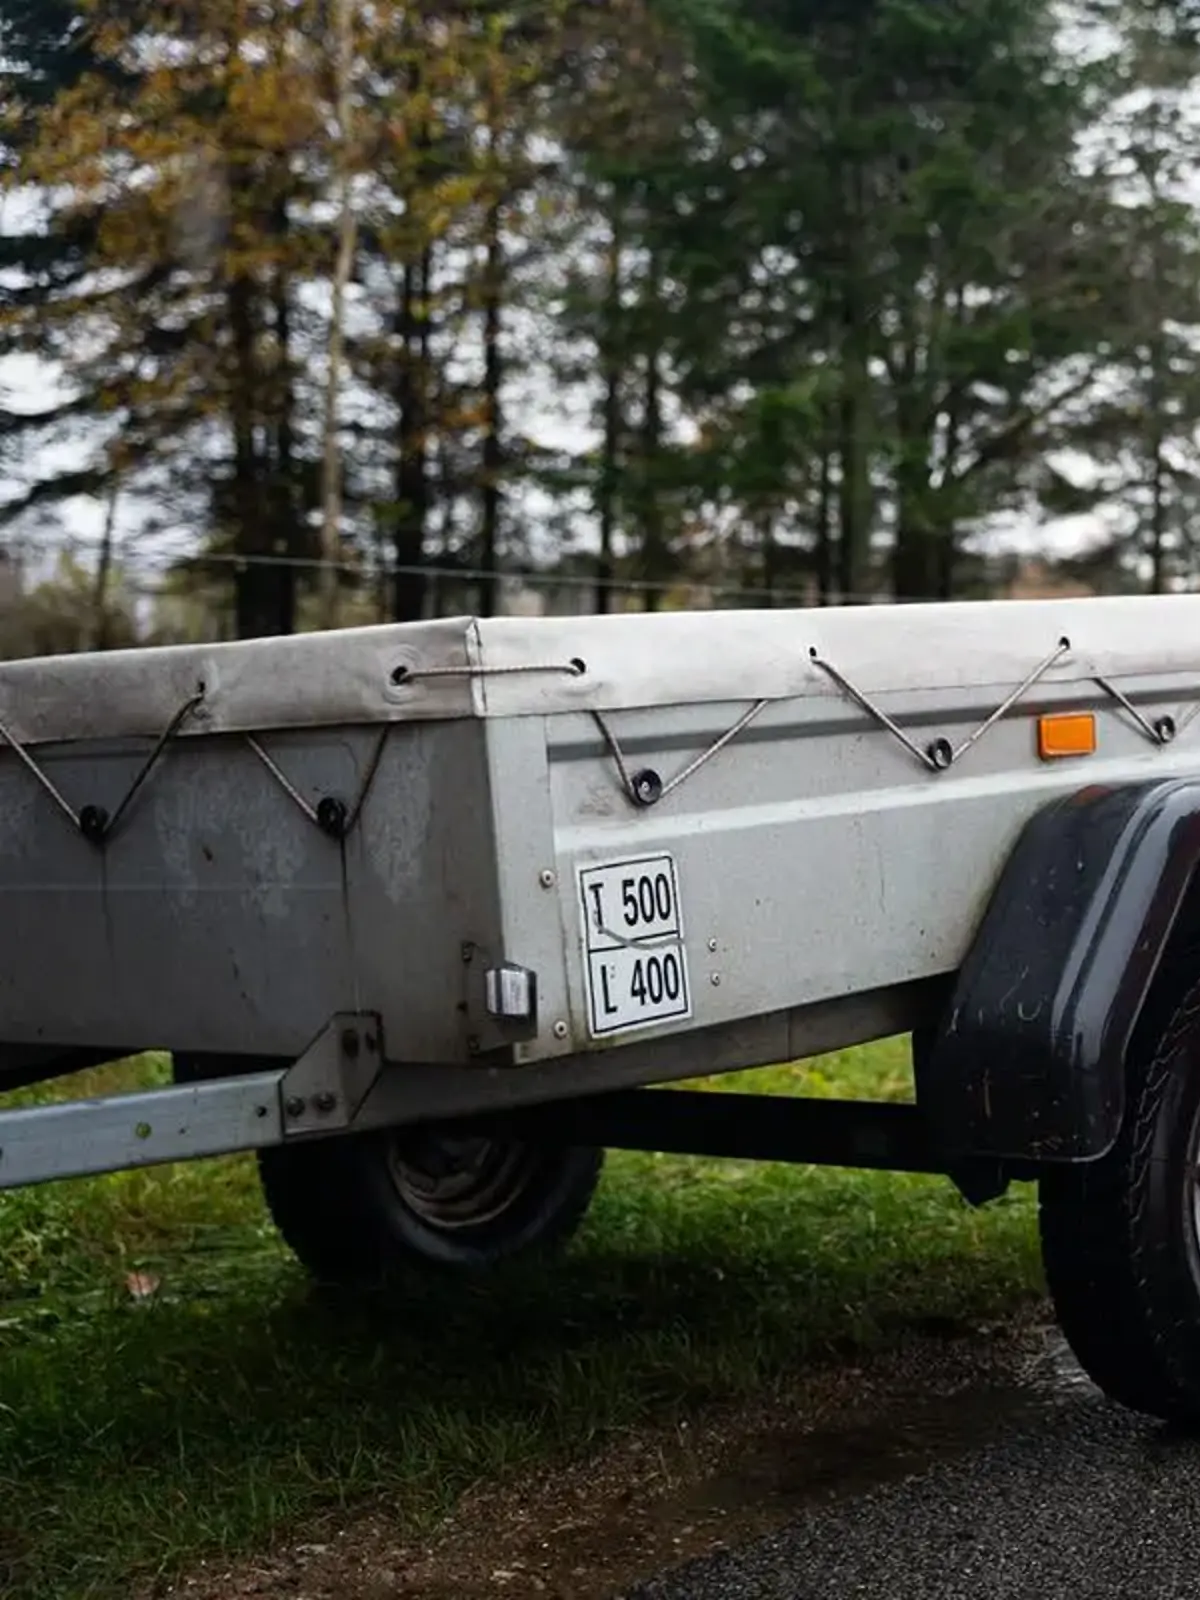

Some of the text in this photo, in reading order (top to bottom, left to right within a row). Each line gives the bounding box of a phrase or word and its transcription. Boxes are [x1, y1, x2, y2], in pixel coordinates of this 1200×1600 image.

[588, 873, 671, 934] T 500
[601, 953, 680, 1015] L 400
